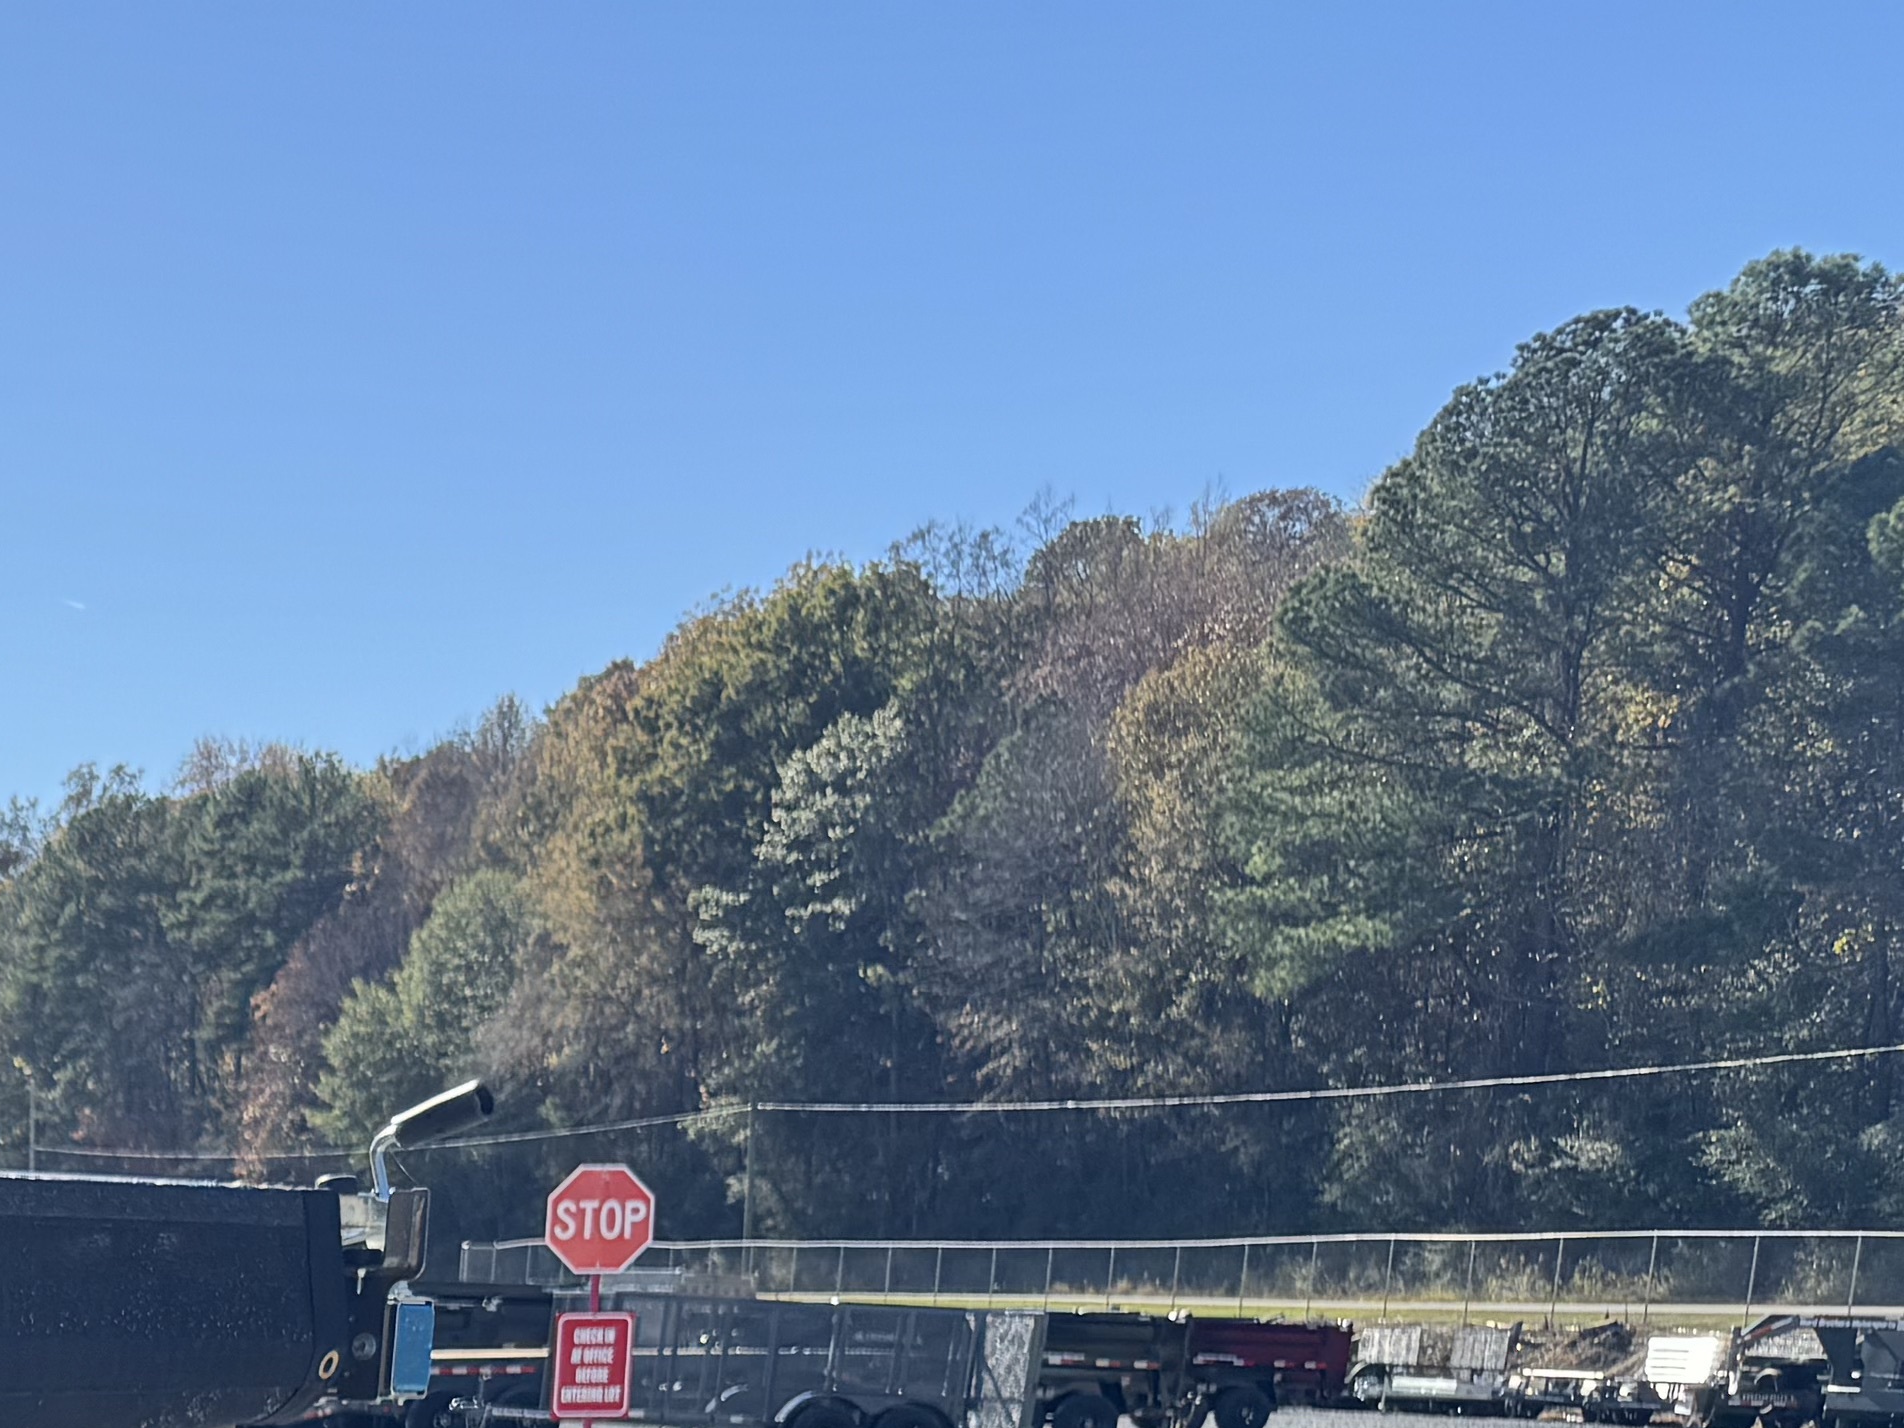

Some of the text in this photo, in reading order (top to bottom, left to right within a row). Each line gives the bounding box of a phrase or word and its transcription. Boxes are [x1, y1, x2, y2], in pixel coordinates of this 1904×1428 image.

[554, 1199, 647, 1241] STOP
[583, 1346, 614, 1365] OFFICE
[575, 1365, 609, 1384] BEFORE
